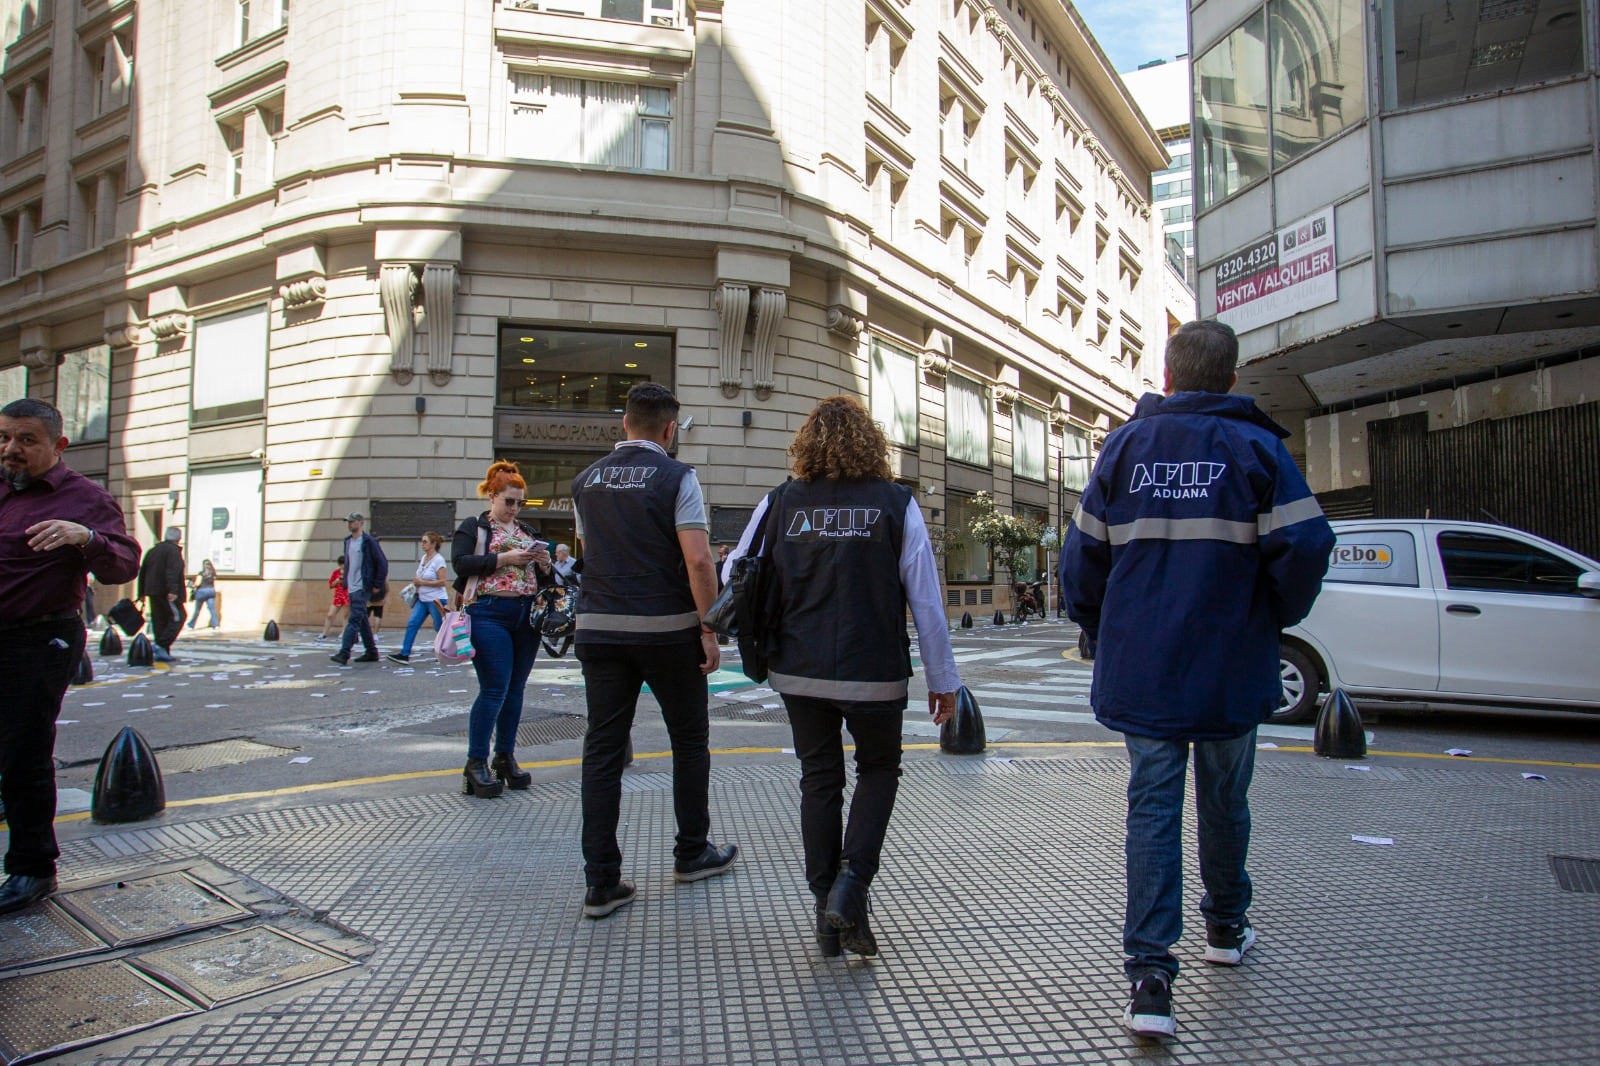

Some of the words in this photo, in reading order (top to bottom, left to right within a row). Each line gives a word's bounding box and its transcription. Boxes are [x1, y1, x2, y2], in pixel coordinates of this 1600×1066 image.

[1216, 241, 1276, 280] 4320-4320
[512, 422, 627, 441] BANCOPATAG
[584, 466, 658, 488] AFIP
[1129, 462, 1226, 494] AFIP
[1152, 488, 1209, 499] ADUANA
[786, 508, 881, 537] AFIP
[1331, 545, 1377, 565] febo
